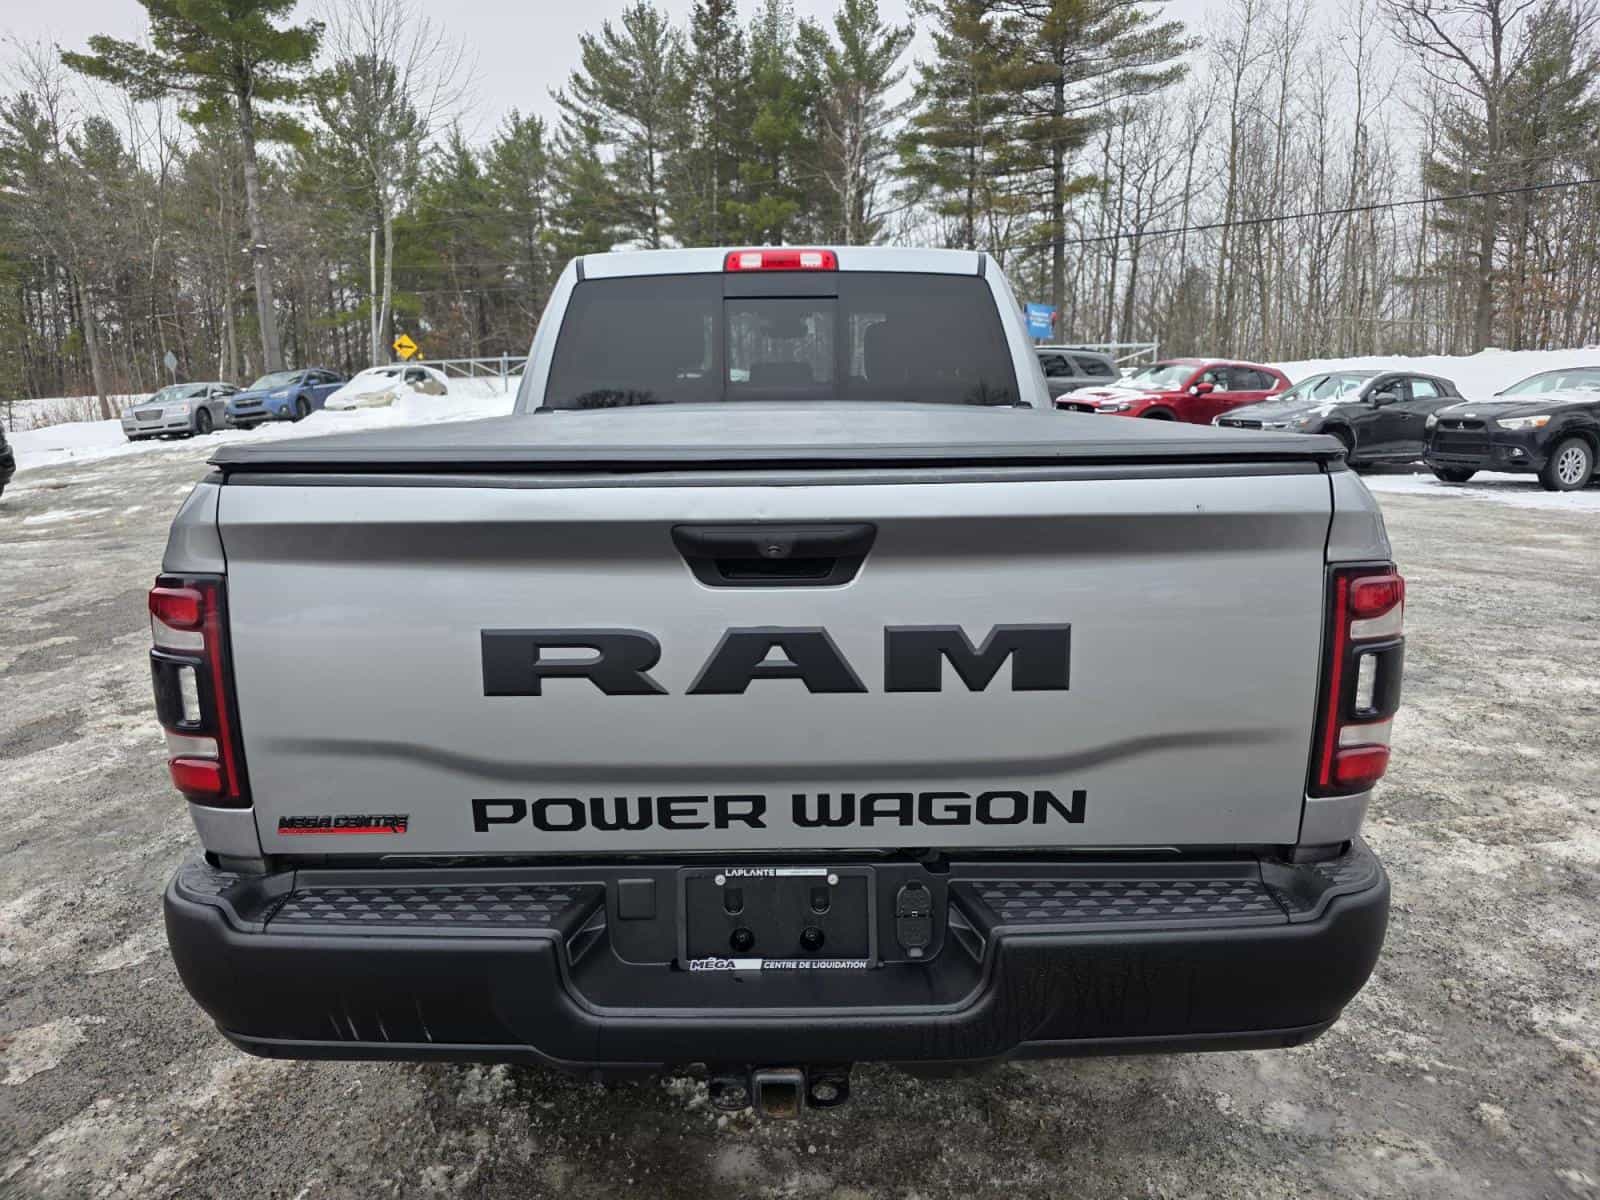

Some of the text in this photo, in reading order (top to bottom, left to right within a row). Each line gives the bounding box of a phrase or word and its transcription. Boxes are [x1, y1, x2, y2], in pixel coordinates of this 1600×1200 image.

[480, 622, 1072, 697] RAM
[471, 789, 1088, 833] POWER WAGON
[333, 814, 408, 833] CENTRE
[725, 868, 775, 877] LAPLANTE
[690, 957, 867, 970] MÉGA CENTRE DE LIQUIDATION
